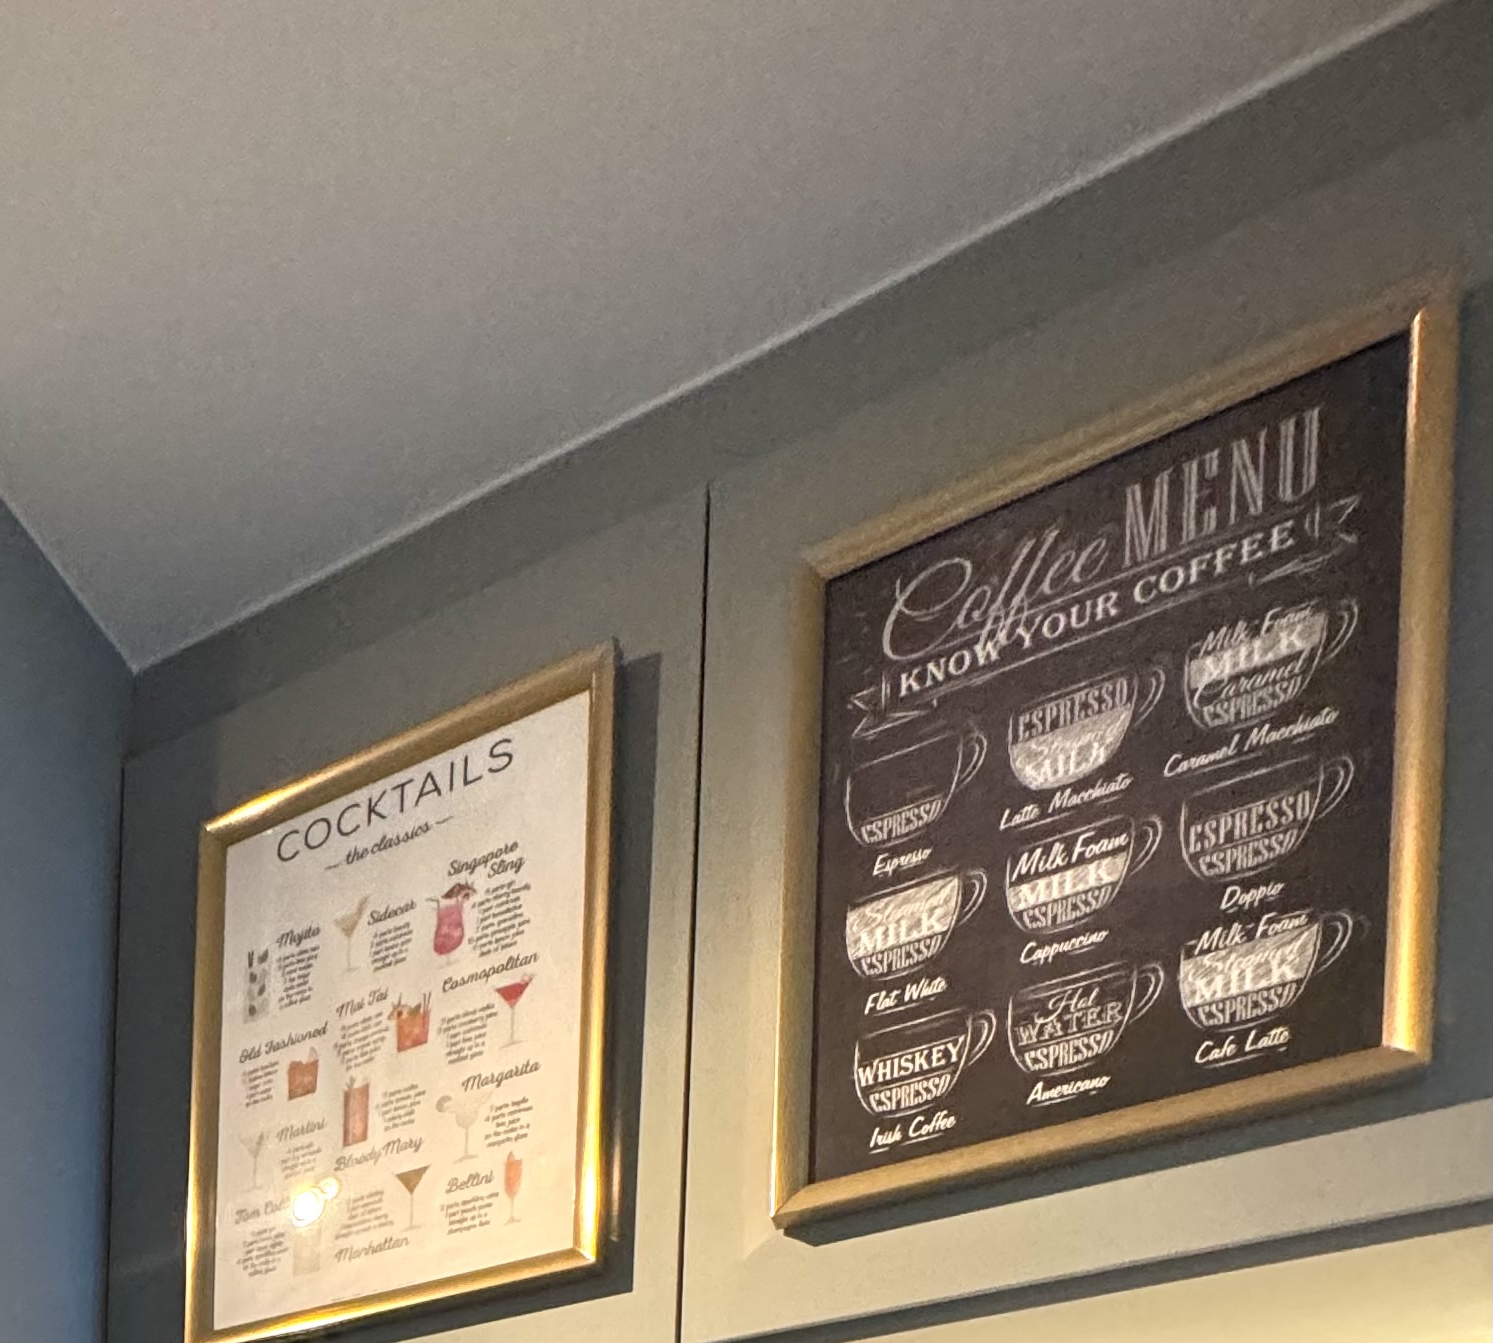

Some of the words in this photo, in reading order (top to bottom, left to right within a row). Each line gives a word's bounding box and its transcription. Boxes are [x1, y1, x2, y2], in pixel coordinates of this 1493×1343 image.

[883, 526, 1107, 661] Coffee
[1123, 406, 1321, 567] MENU
[898, 634, 1002, 698] KNOW
[1016, 590, 1118, 650] YOUR
[1133, 518, 1296, 603] COFFEE
[1193, 648, 1309, 709] Caramel
[1017, 677, 1129, 742] ESPRESSO
[1203, 676, 1303, 728] ESPRESSO
[1164, 733, 1241, 778] Caramel
[1244, 706, 1340, 751] Macchiato
[276, 737, 514, 863] COCKTAILS
[860, 799, 942, 844] ESPRESSO
[999, 803, 1042, 831] Latte
[1048, 772, 1135, 814] Macchiato
[345, 848, 370, 866] the
[370, 819, 432, 854] classics
[1189, 790, 1311, 854] ESPRESSO
[447, 840, 519, 877] Singapore
[487, 856, 526, 879] Sling
[872, 847, 933, 877] Espresso
[1011, 841, 1069, 882] Milk
[1071, 830, 1130, 864] Foam
[1198, 828, 1299, 877] ESPRESSO
[1017, 856, 1117, 909] MILK
[1219, 881, 1285, 911] Doppio
[367, 899, 417, 926] Sidecar
[1022, 885, 1112, 930] ESPRESSO
[276, 925, 321, 949] Mojito
[856, 907, 948, 955] MILK
[1019, 929, 1110, 967] Cappuccino
[1193, 921, 1248, 956] Milk
[1255, 911, 1309, 940] Foam
[442, 952, 540, 994] Cosmopolitan
[860, 934, 942, 976] ESPRESSO
[864, 990, 902, 1015] Flat
[904, 975, 948, 1003] White
[1194, 958, 1296, 1004] MILK
[1014, 1001, 1123, 1046] WATER
[1197, 982, 1298, 1027] ESPRESSO
[264, 1020, 329, 1055] Fashioned
[1023, 1029, 1115, 1071] ESPRESSO
[1194, 1035, 1237, 1064] Cafe
[1244, 1026, 1291, 1053] Latte
[461, 1058, 542, 1093] Margarita
[858, 1034, 966, 1088] WHISKEY
[869, 1073, 951, 1113] ESPRESSO
[1025, 1075, 1112, 1106] Americano
[276, 1117, 327, 1143] Martini
[908, 1109, 957, 1138] Coffee
[333, 1147, 382, 1173] Bloody
[382, 1136, 424, 1159] Mary
[444, 1169, 495, 1194] Bellini
[334, 1234, 410, 1264] Manhattan
